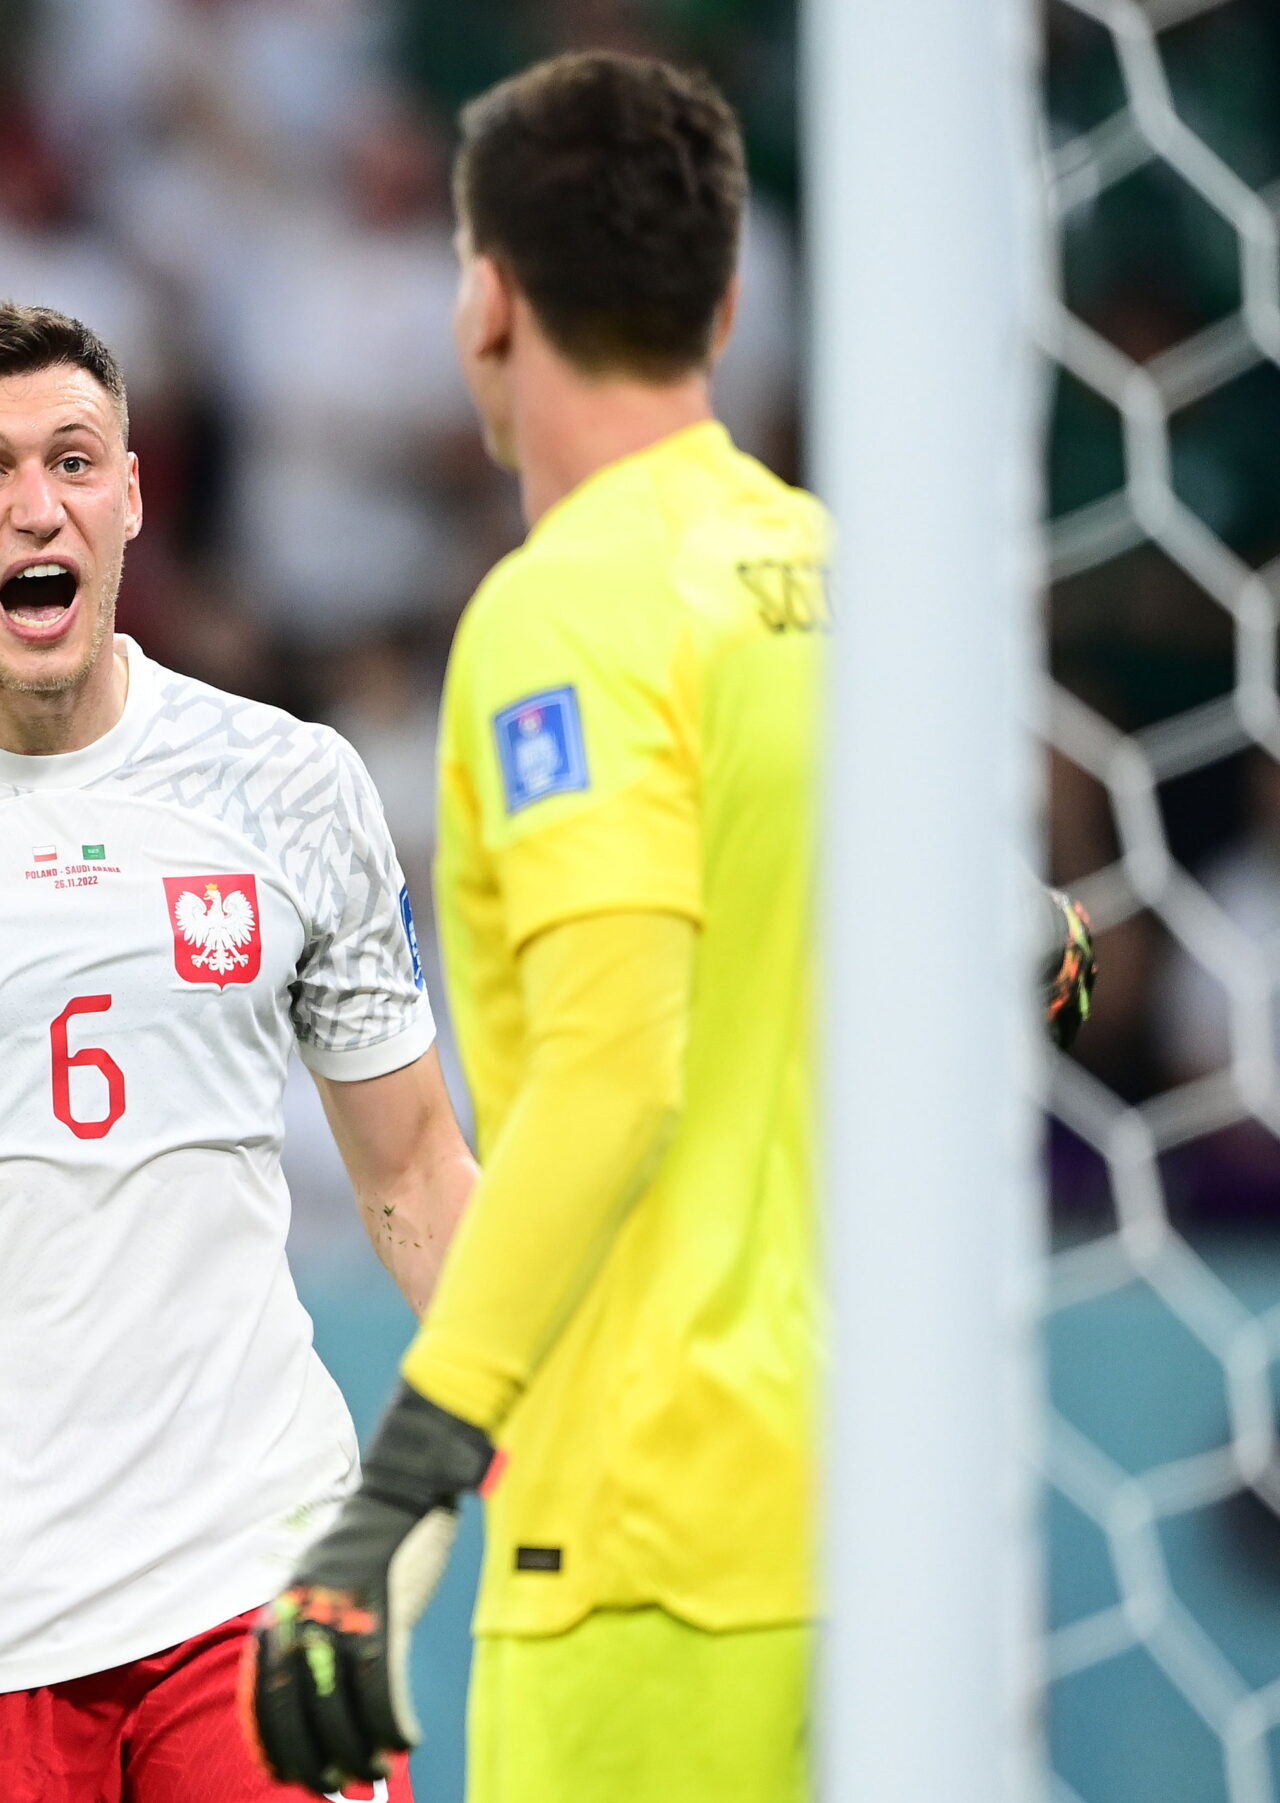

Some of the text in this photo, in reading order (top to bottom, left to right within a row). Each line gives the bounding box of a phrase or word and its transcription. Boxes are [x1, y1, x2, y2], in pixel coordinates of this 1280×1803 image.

[25, 868, 58, 879] POLAND
[65, 864, 91, 875] SAUDI
[54, 875, 99, 889] 26.11.2022
[50, 993, 126, 1140] 6
